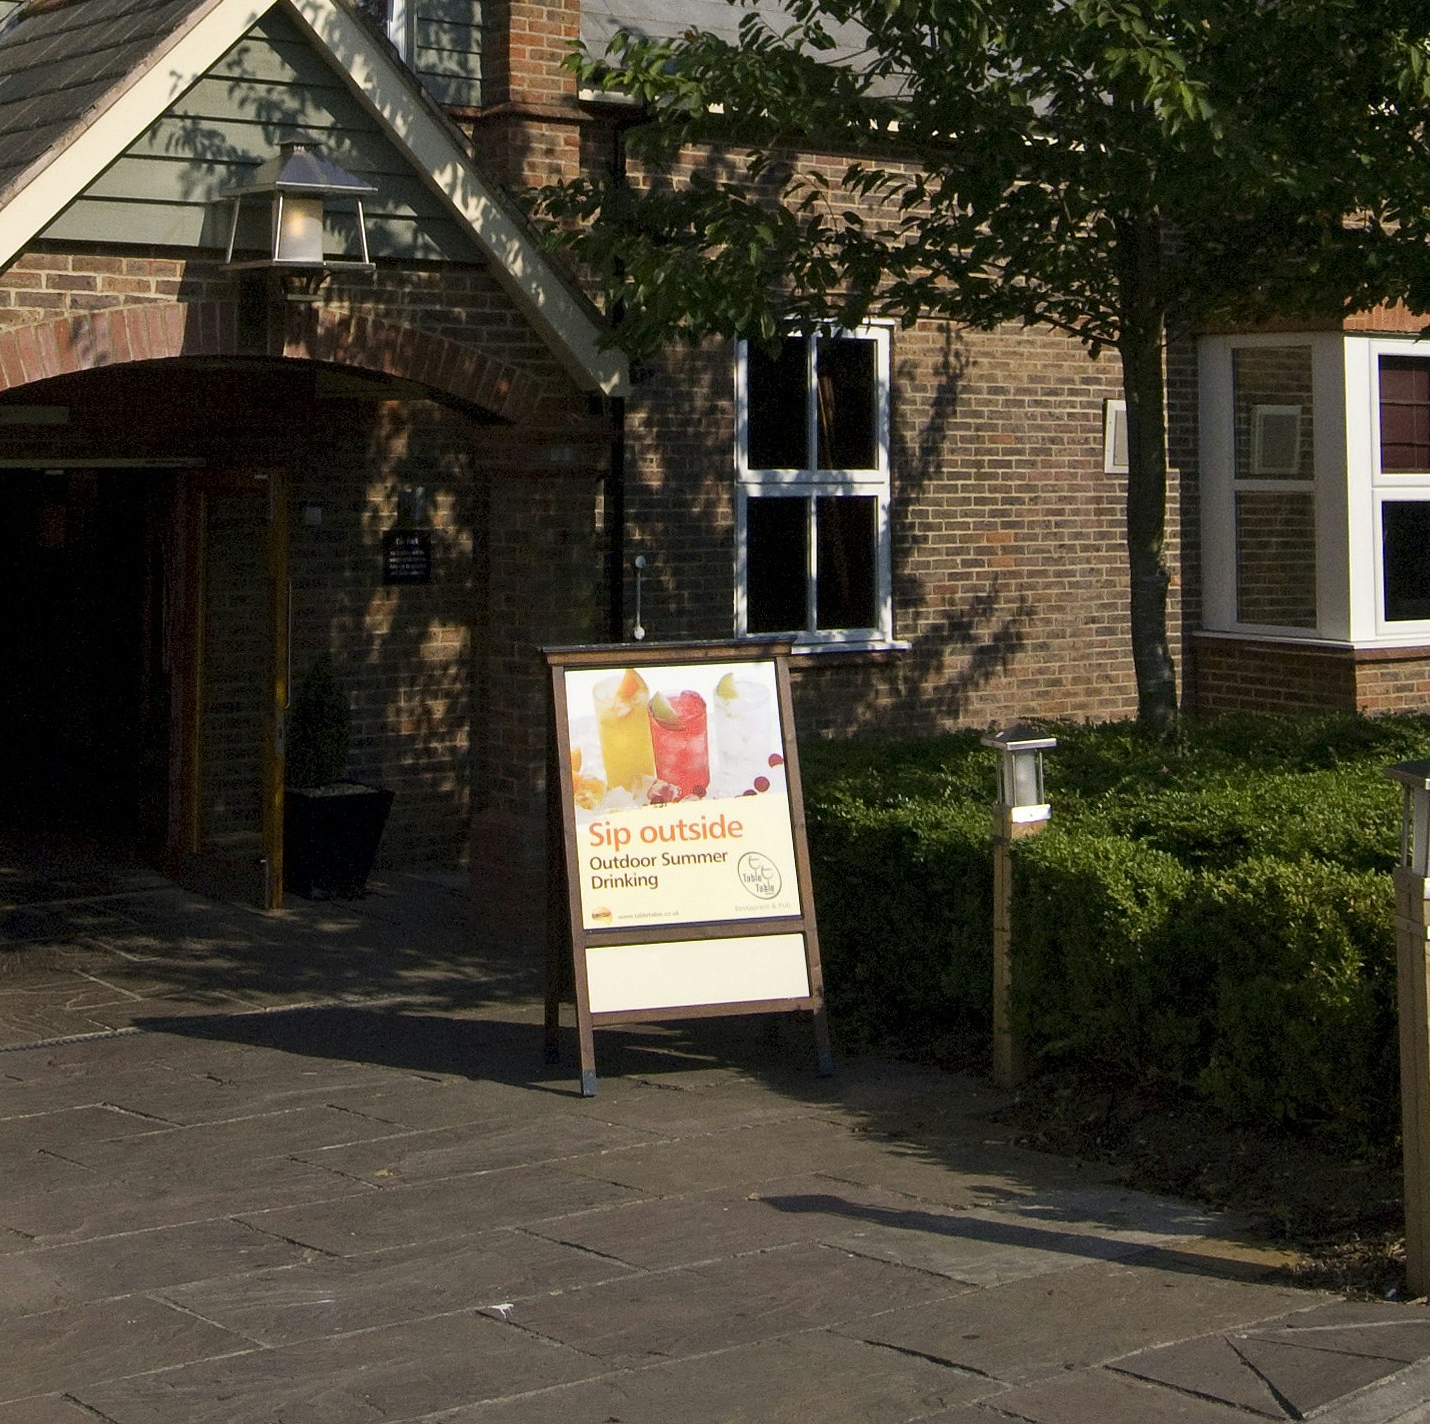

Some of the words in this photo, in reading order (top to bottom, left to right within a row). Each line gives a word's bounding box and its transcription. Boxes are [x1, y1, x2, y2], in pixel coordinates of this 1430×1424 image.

[589, 822, 631, 851] Sip
[640, 814, 743, 844] outside
[590, 854, 657, 870] Outdoor
[662, 851, 728, 866] Summer
[591, 872, 659, 890] Drinking
[743, 872, 762, 883] Table
[756, 881, 774, 893] Table
